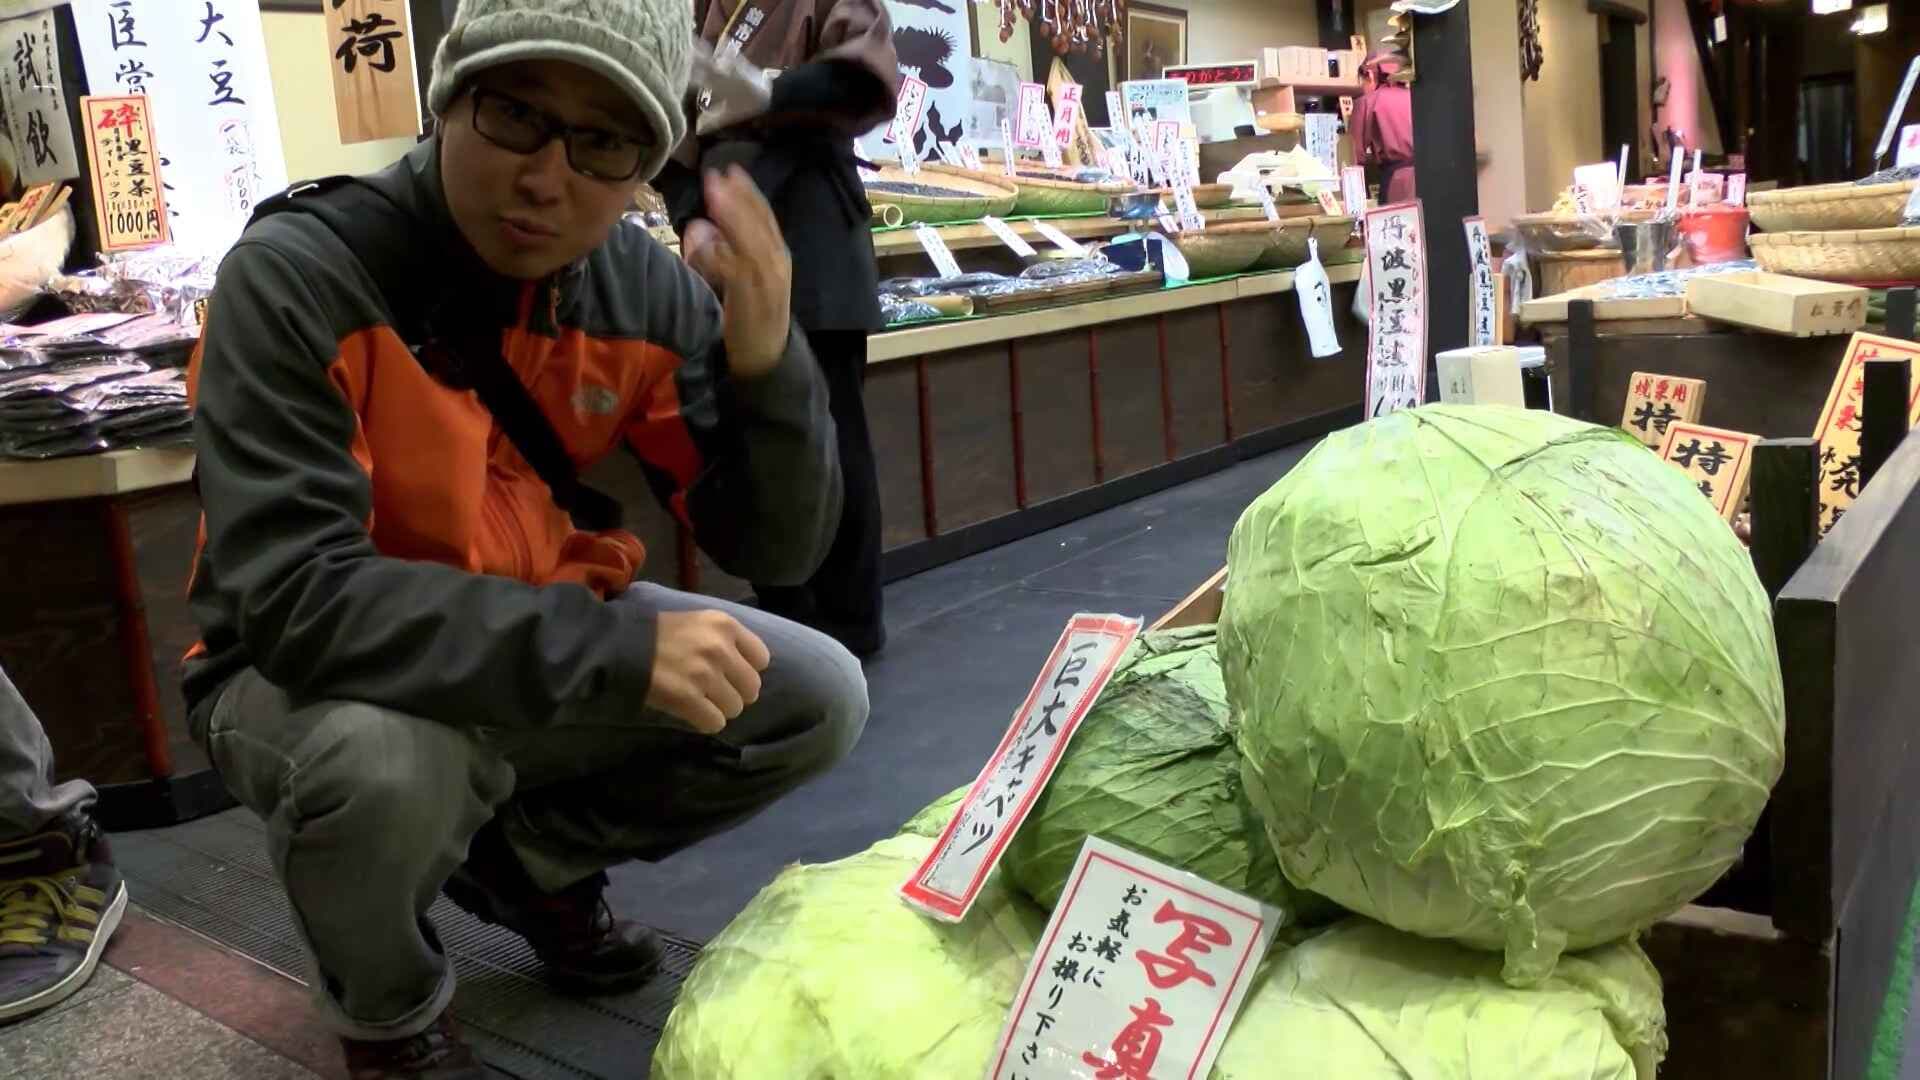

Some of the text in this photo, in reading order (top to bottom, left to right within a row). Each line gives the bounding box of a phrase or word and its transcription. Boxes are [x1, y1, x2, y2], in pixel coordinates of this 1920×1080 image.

[195, 1, 246, 106] 大豆
[332, 0, 403, 73] 荷
[14, 31, 58, 167] 試飲
[1056, 86, 1077, 144] 正月用
[124, 138, 153, 198] 黒豆茶
[109, 209, 160, 234] 1000円
[960, 641, 1098, 856] 巨大キャベツ
[1082, 883, 1148, 988] お気軽に
[1081, 899, 1233, 1080] 写真
